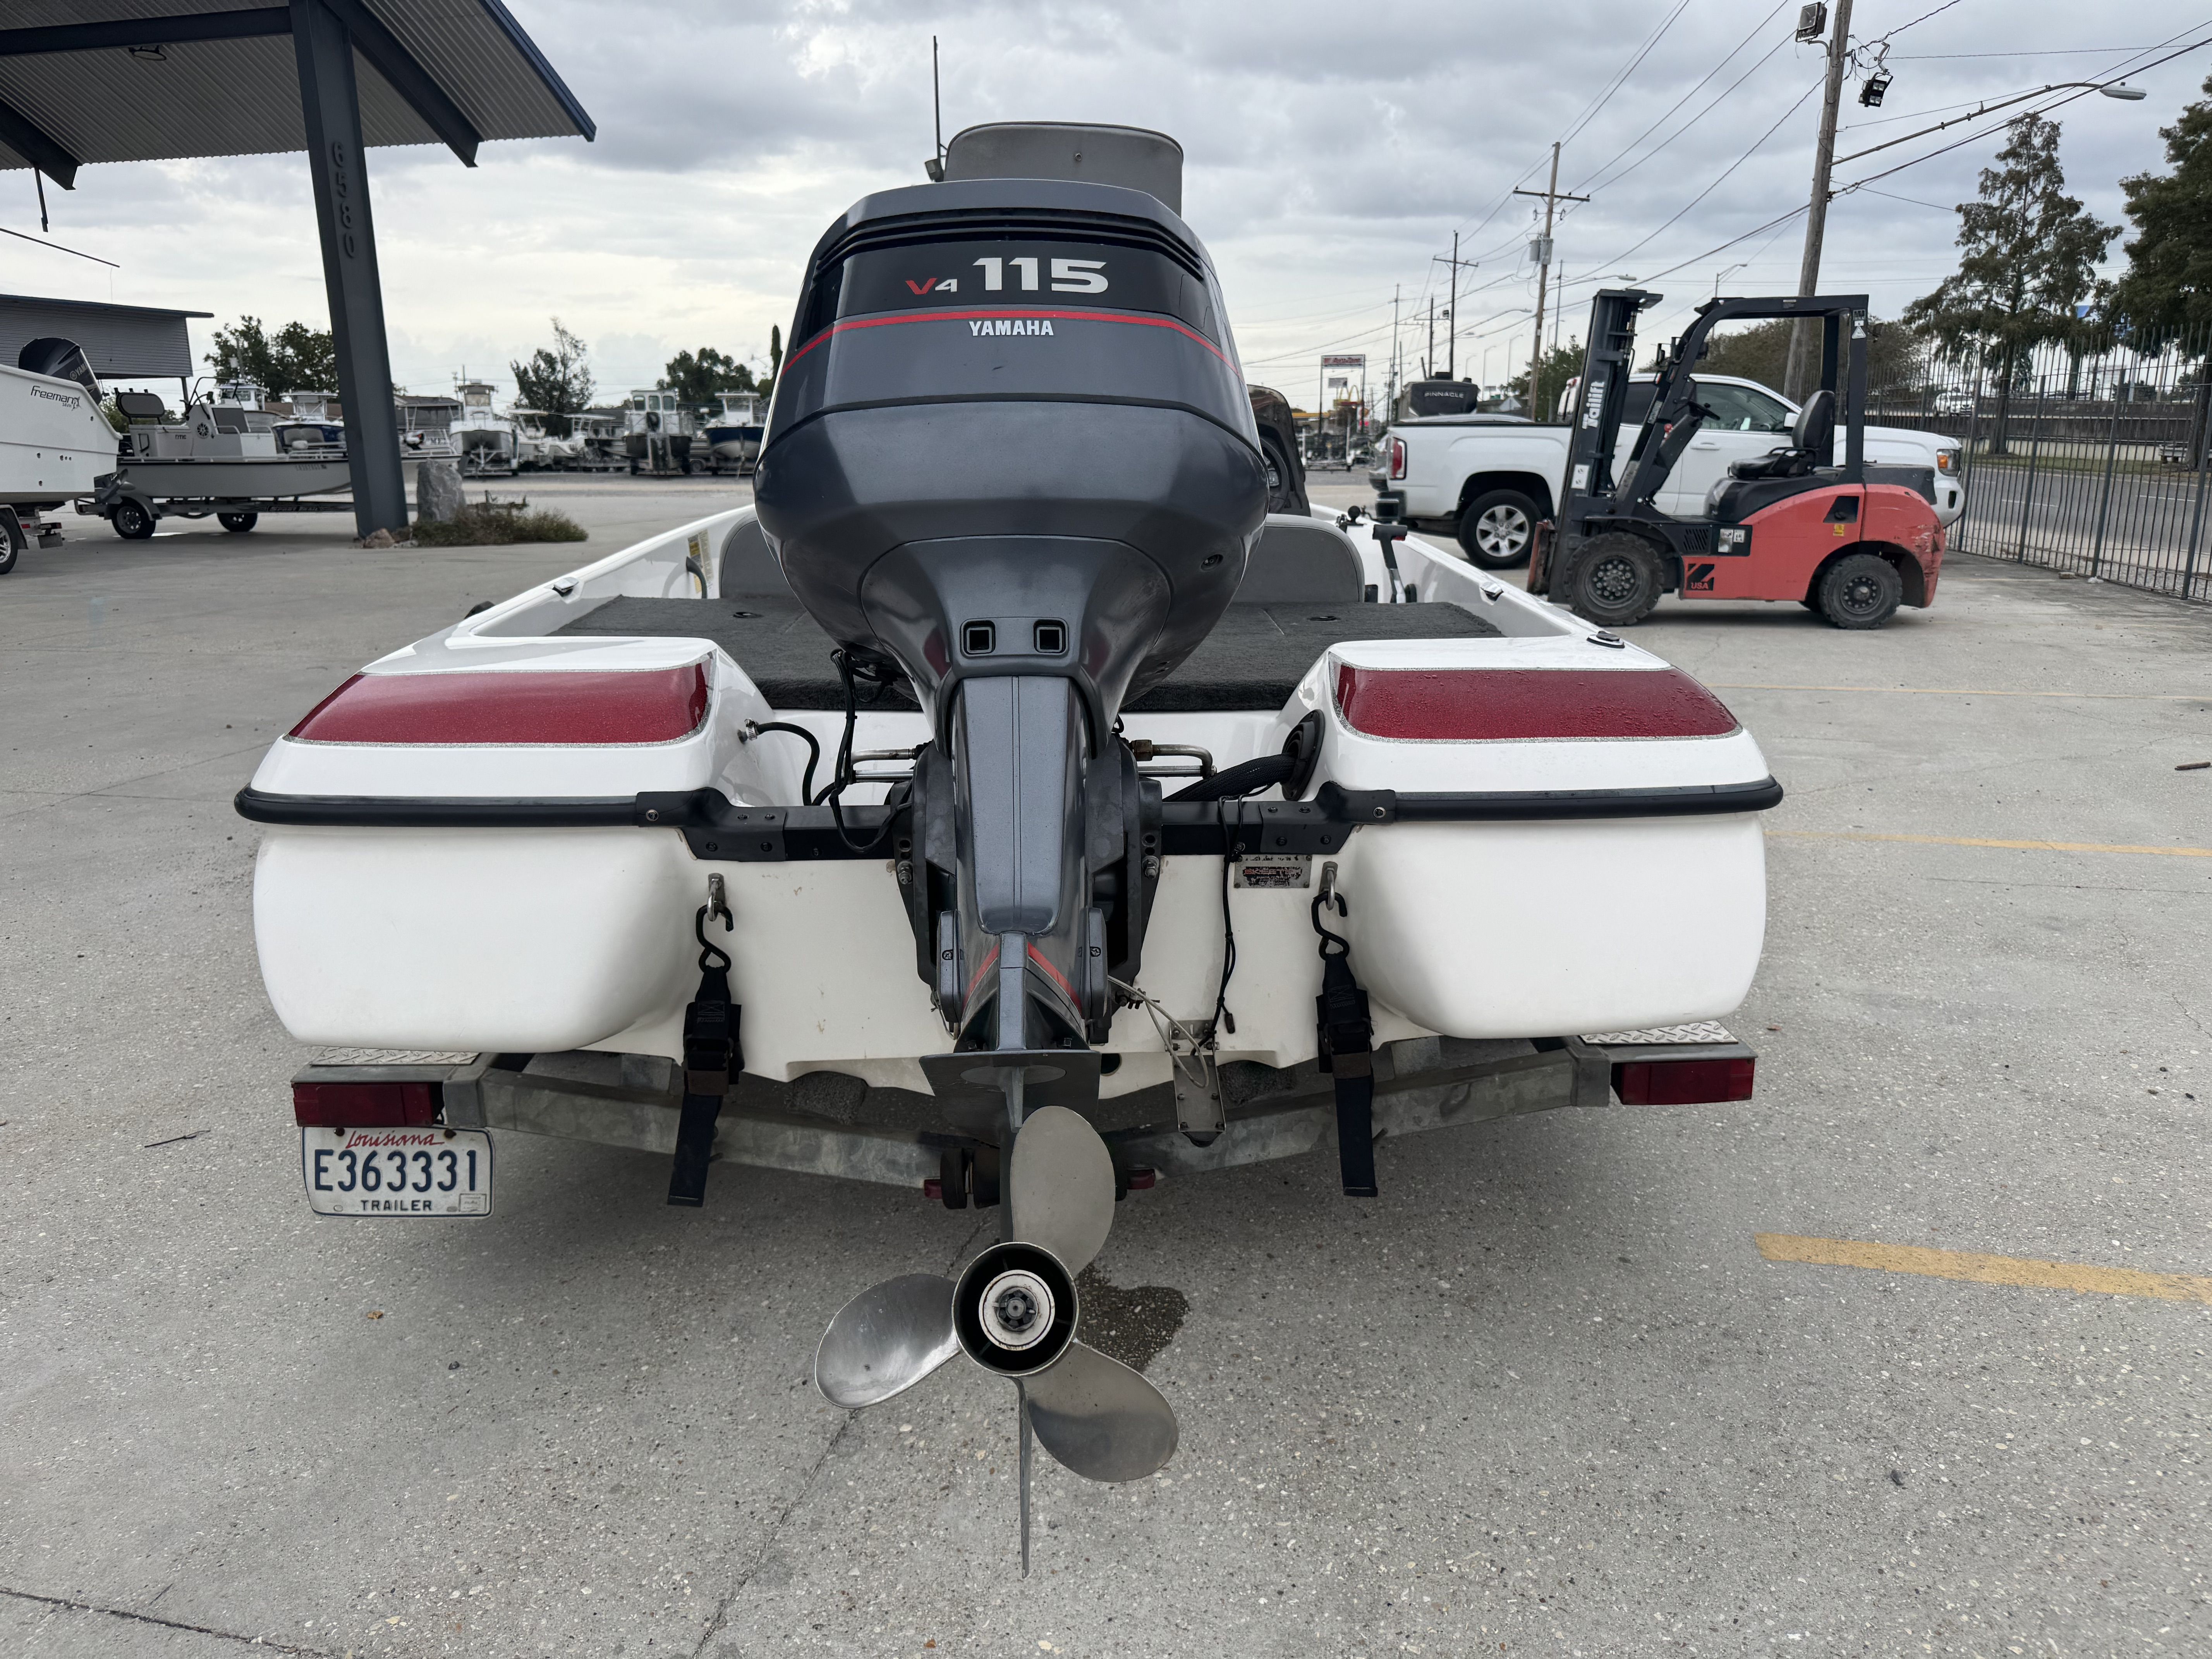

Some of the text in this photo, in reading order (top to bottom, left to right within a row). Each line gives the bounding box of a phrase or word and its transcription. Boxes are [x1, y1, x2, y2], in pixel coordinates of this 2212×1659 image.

[332, 141, 354, 259] 6580
[905, 257, 1108, 295] V4 115
[969, 320, 1054, 336] YAMAHA
[345, 1130, 445, 1149] Louisiana
[314, 1149, 476, 1192] E363331
[361, 1200, 433, 1211] TRAILER
